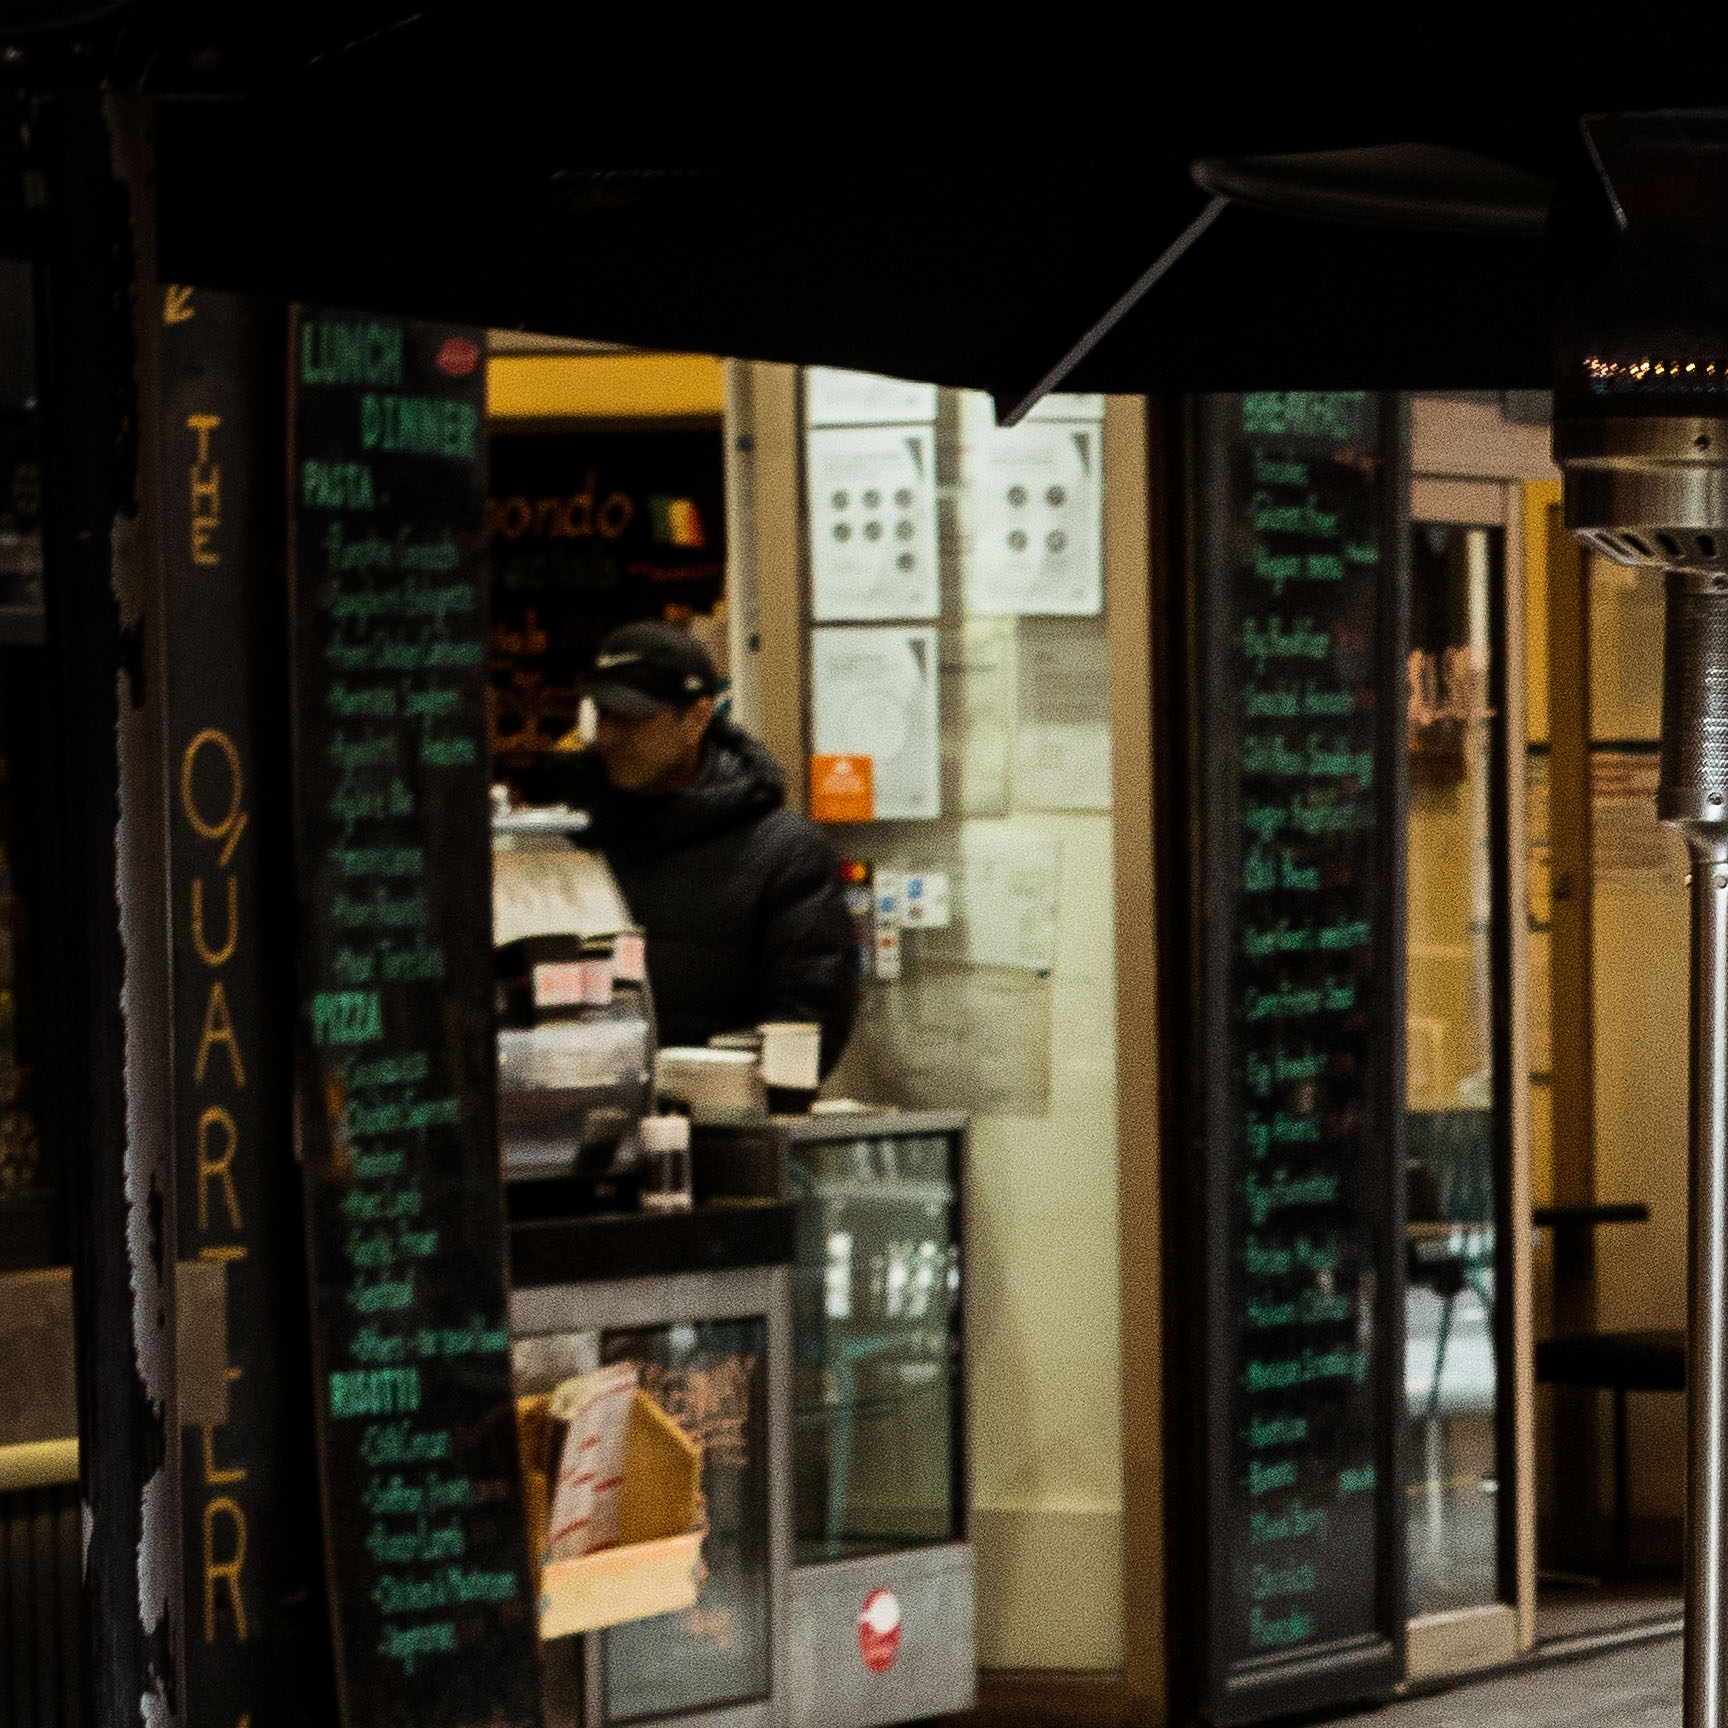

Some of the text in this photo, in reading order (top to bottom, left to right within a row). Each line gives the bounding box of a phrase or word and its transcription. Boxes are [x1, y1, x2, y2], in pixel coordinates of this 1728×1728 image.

[302, 321, 404, 386] LUNCH
[361, 393, 477, 459] DINNER
[187, 414, 222, 567] THE
[302, 460, 376, 512] PASTA
[491, 465, 638, 542] ondo
[311, 991, 385, 1045] PIZZA
[329, 1367, 422, 1420] RISOTTO
